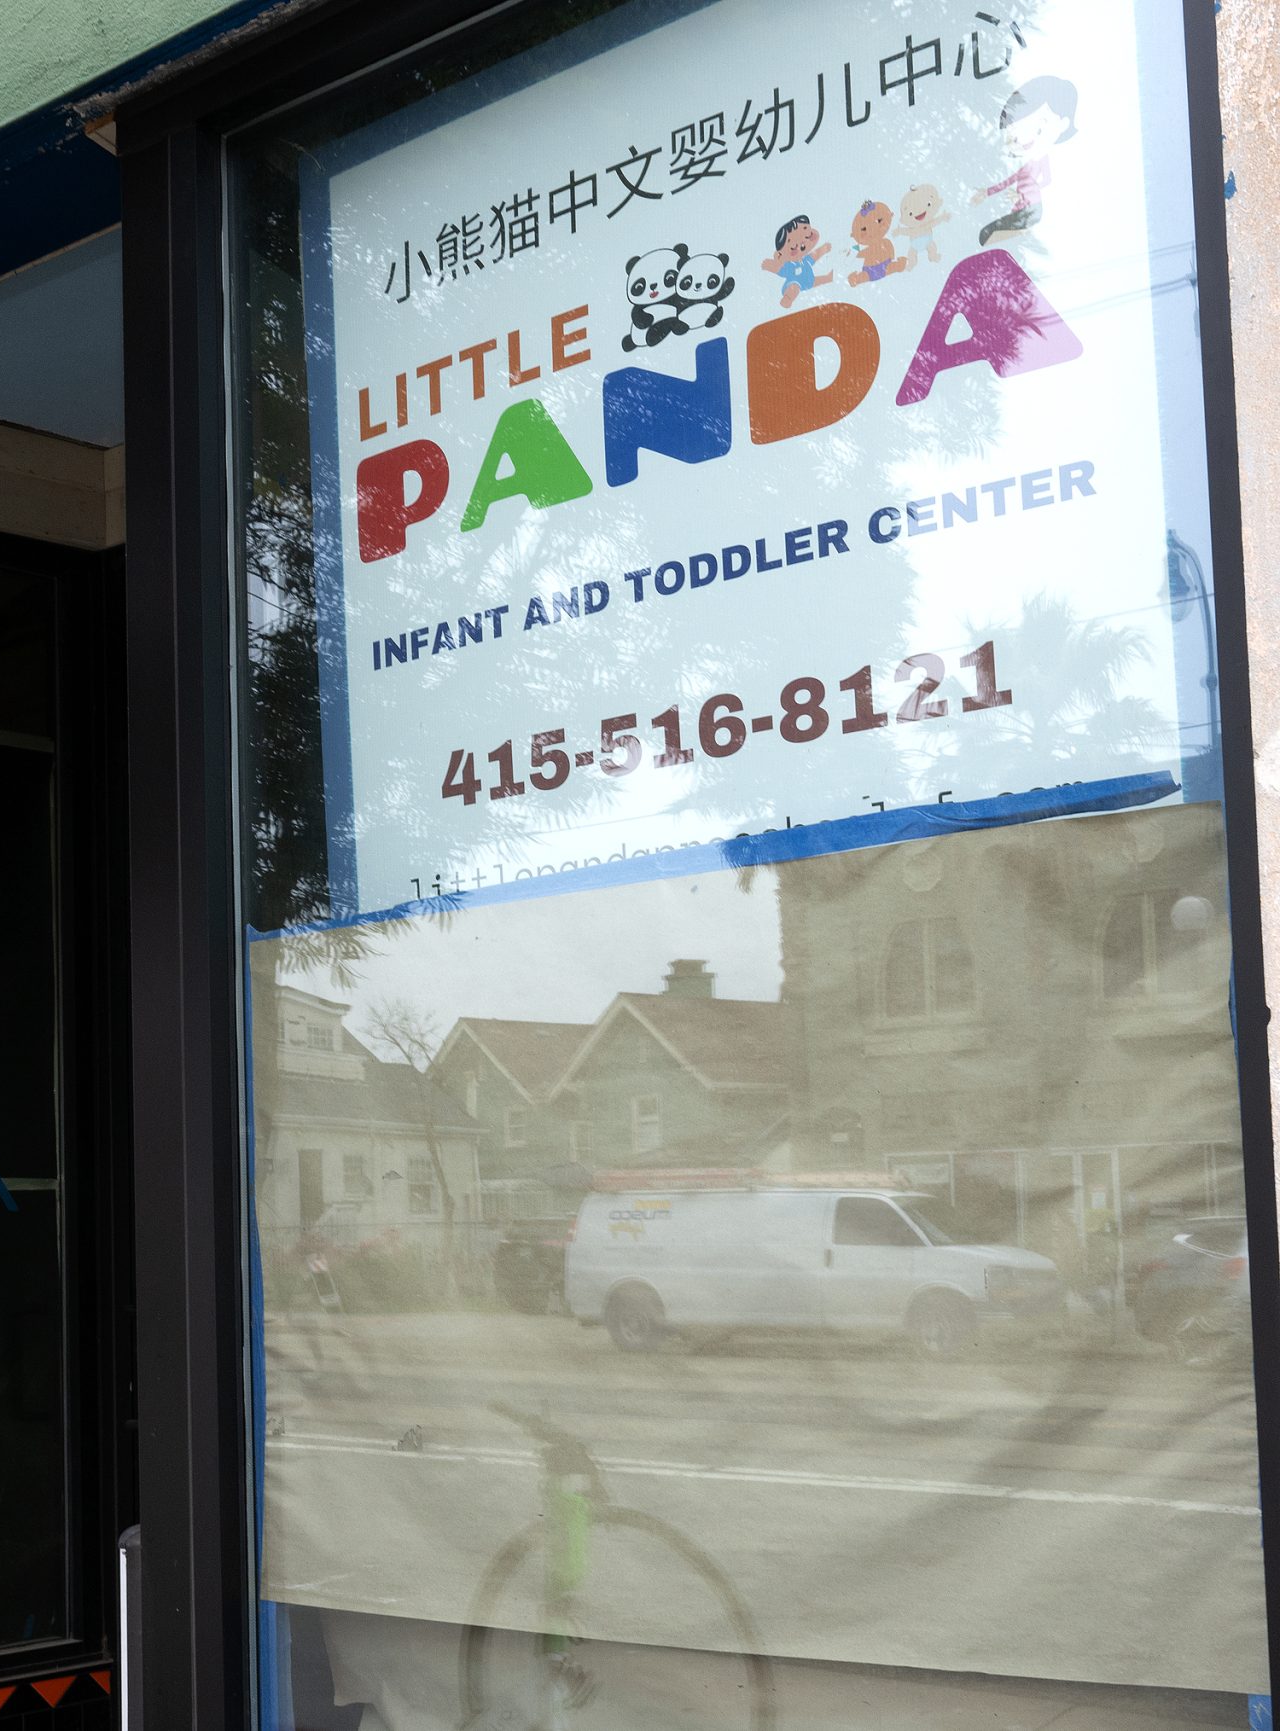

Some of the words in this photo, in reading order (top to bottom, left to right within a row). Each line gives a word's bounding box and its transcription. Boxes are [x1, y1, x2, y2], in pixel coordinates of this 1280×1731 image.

[384, 10, 1027, 304] 小熊猫中文婴幼儿中心
[356, 248, 1084, 564] PANDA
[358, 304, 592, 442] LITTLE
[372, 606, 509, 671] INFANT
[523, 580, 610, 631] AND
[624, 518, 850, 603] TODDLER
[869, 460, 1097, 544] CENTER
[441, 640, 1014, 806] 415-516-8121
